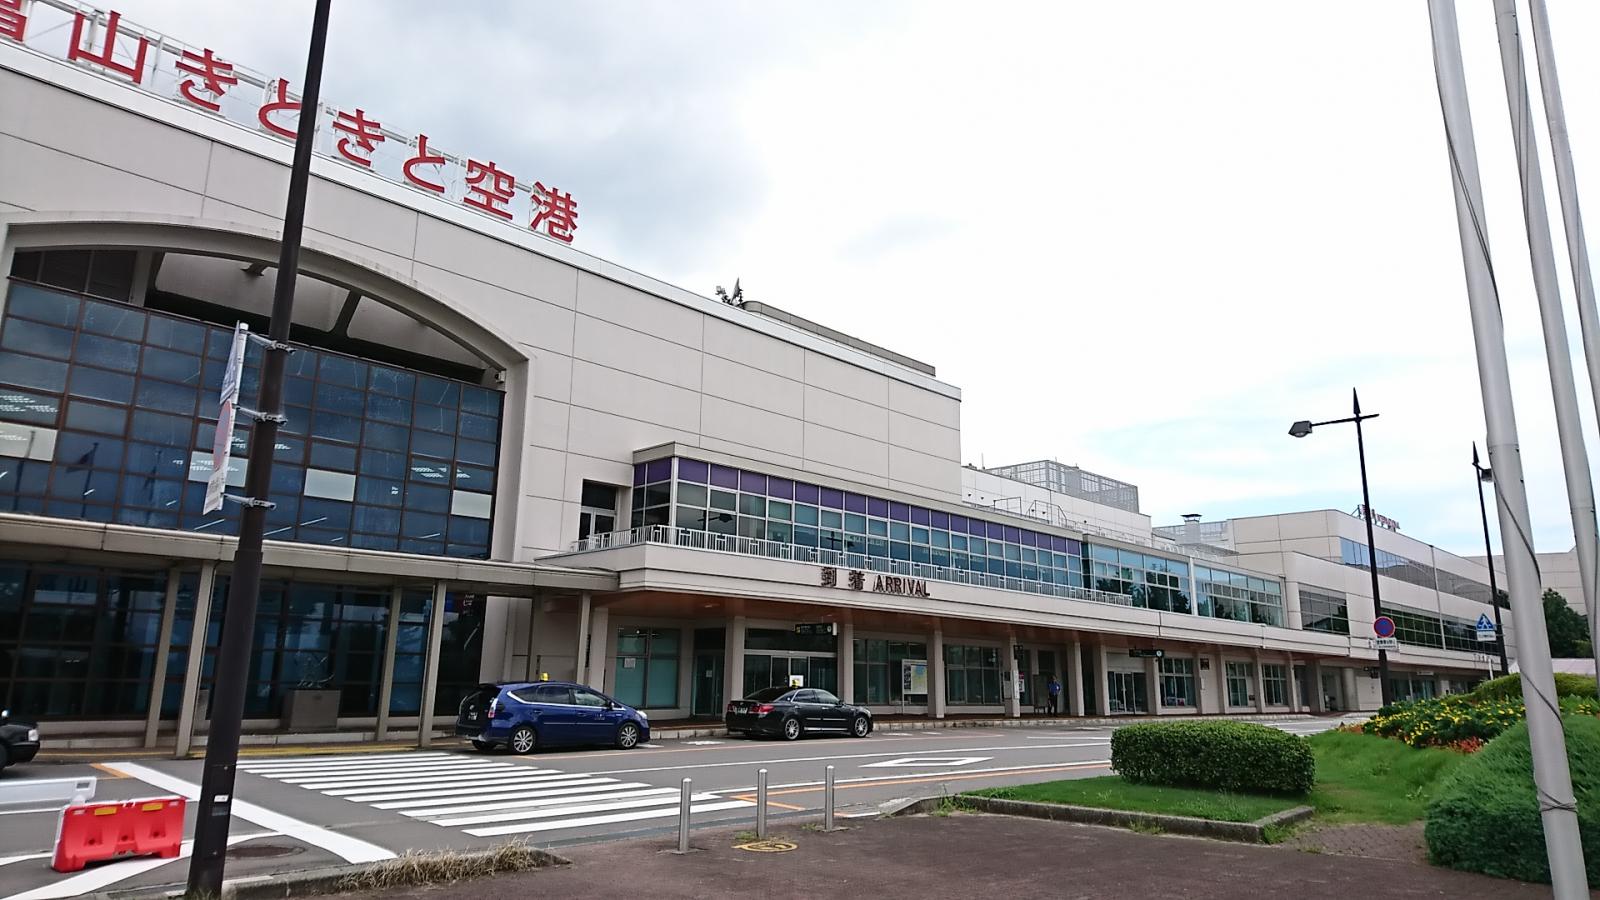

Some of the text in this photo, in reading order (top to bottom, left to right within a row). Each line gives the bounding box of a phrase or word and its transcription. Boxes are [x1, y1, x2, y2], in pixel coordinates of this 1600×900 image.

[0, 0, 578, 243] 山きときと空港
[820, 567, 931, 597] 到着 ARRIVAL
